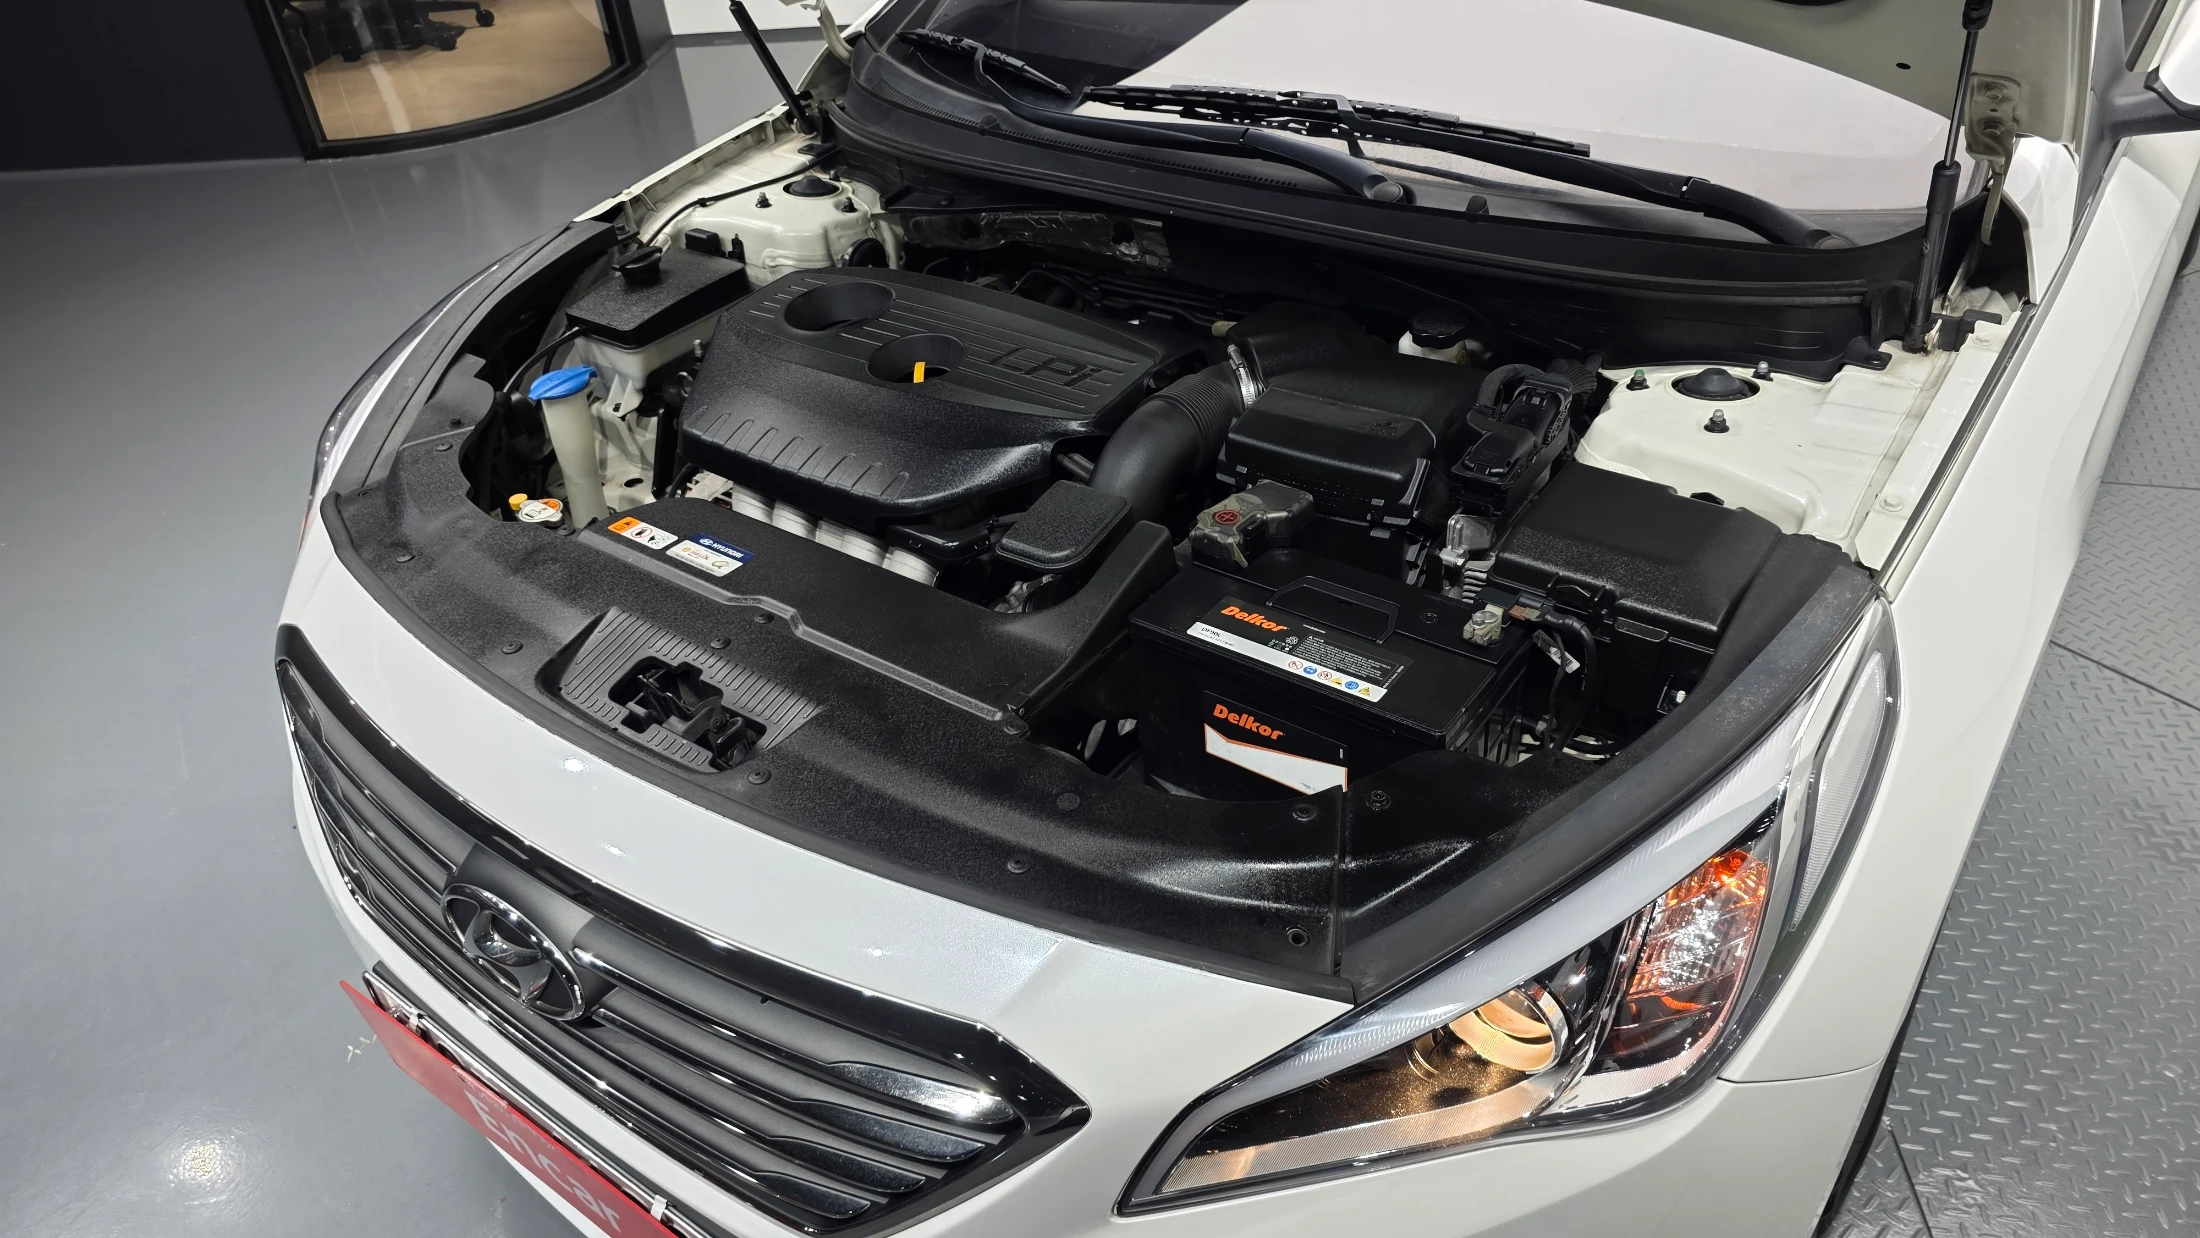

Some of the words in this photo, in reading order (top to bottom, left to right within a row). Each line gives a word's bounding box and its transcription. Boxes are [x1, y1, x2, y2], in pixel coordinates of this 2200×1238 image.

[1220, 605, 1288, 632] Delkor
[1213, 703, 1285, 740] Delkor
[463, 1087, 622, 1233] Encar
